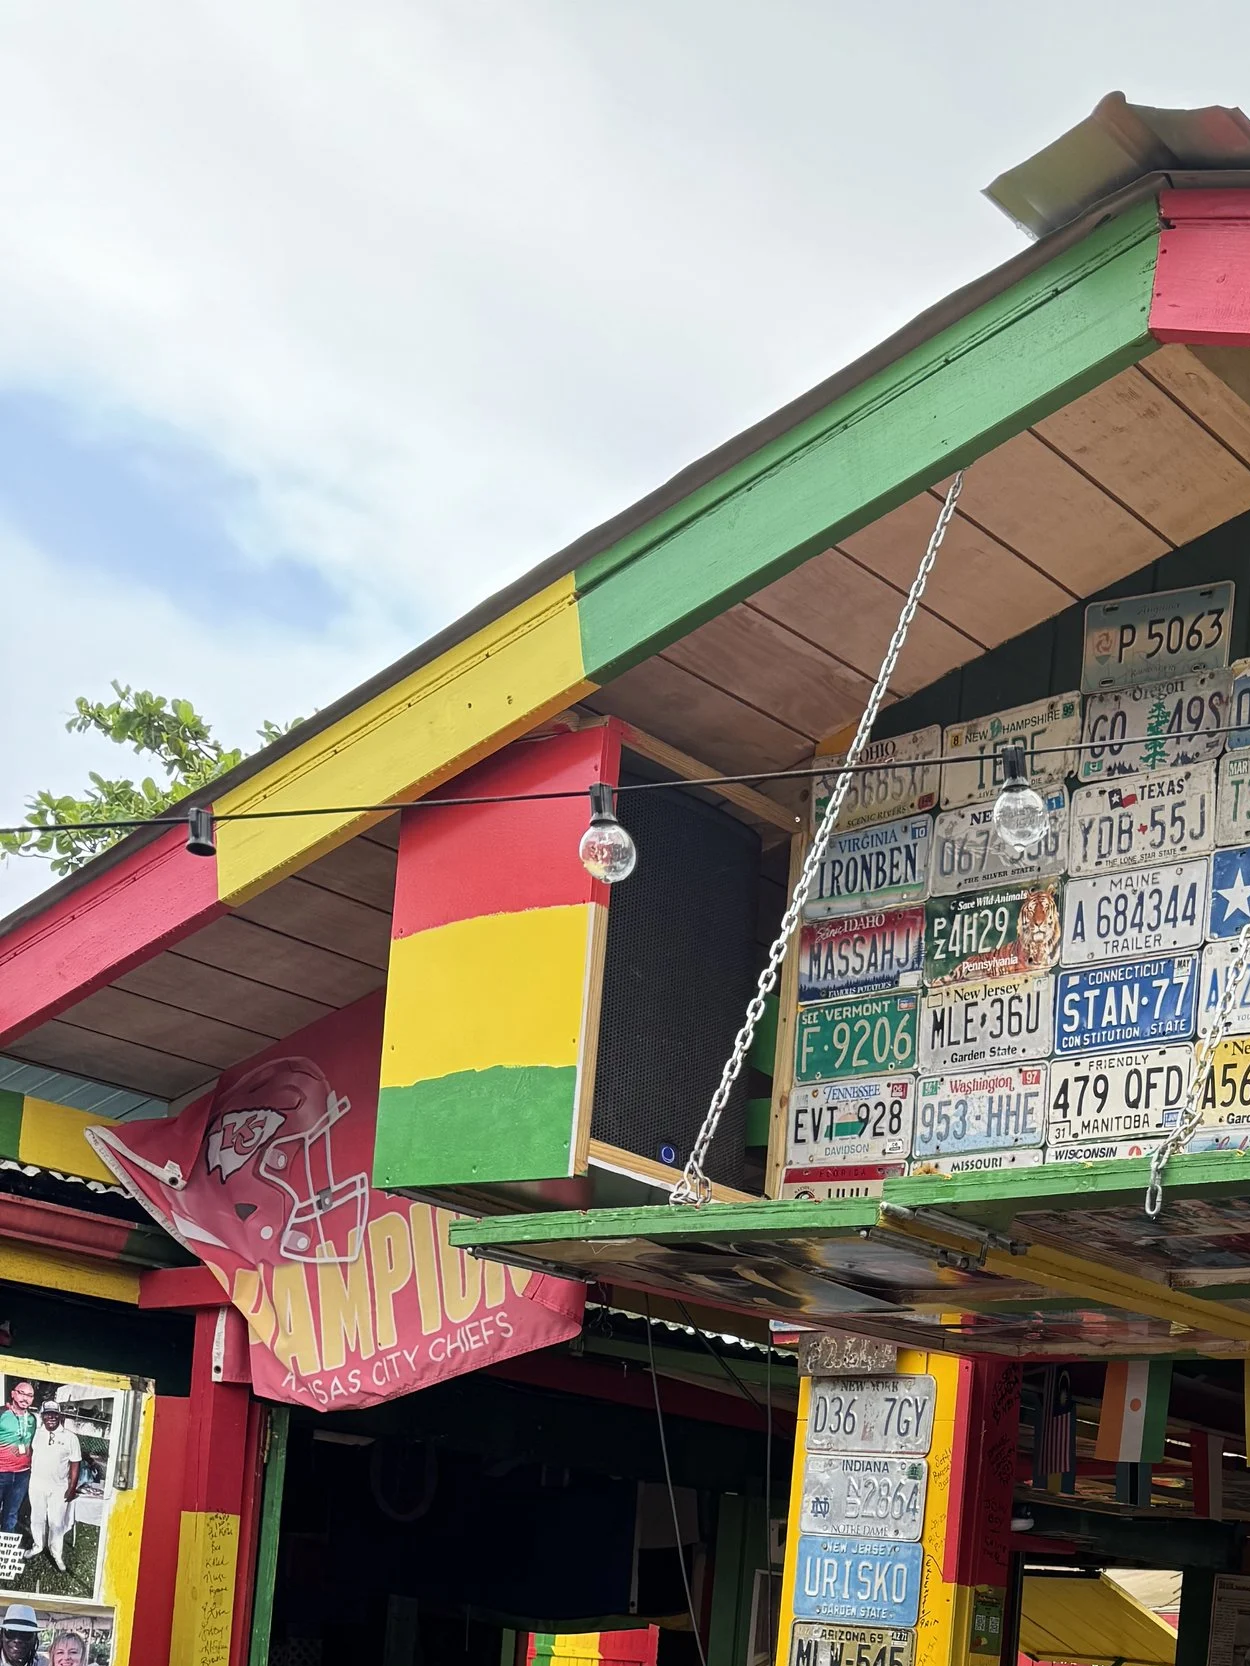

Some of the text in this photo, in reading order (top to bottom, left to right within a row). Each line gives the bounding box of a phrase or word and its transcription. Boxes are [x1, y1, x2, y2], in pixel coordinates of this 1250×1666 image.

[1119, 607, 1226, 664] P 5063
[861, 740, 897, 757] OHIO
[1139, 777, 1185, 801] TEXAS
[838, 830, 898, 856] VIRGINIA
[1110, 873, 1161, 894] MAINE
[1104, 933, 1164, 960] TRAILER
[1088, 961, 1167, 988] CONNECTICUT
[951, 1046, 1019, 1065] Garden State
[1081, 1114, 1151, 1140] MANITOBA
[1055, 1144, 1119, 1161] WISCONSIN
[949, 1157, 1003, 1174] MISSOURI
[371, 1311, 515, 1387] CITY CHIEFS
[841, 1460, 890, 1474] INDIANA
